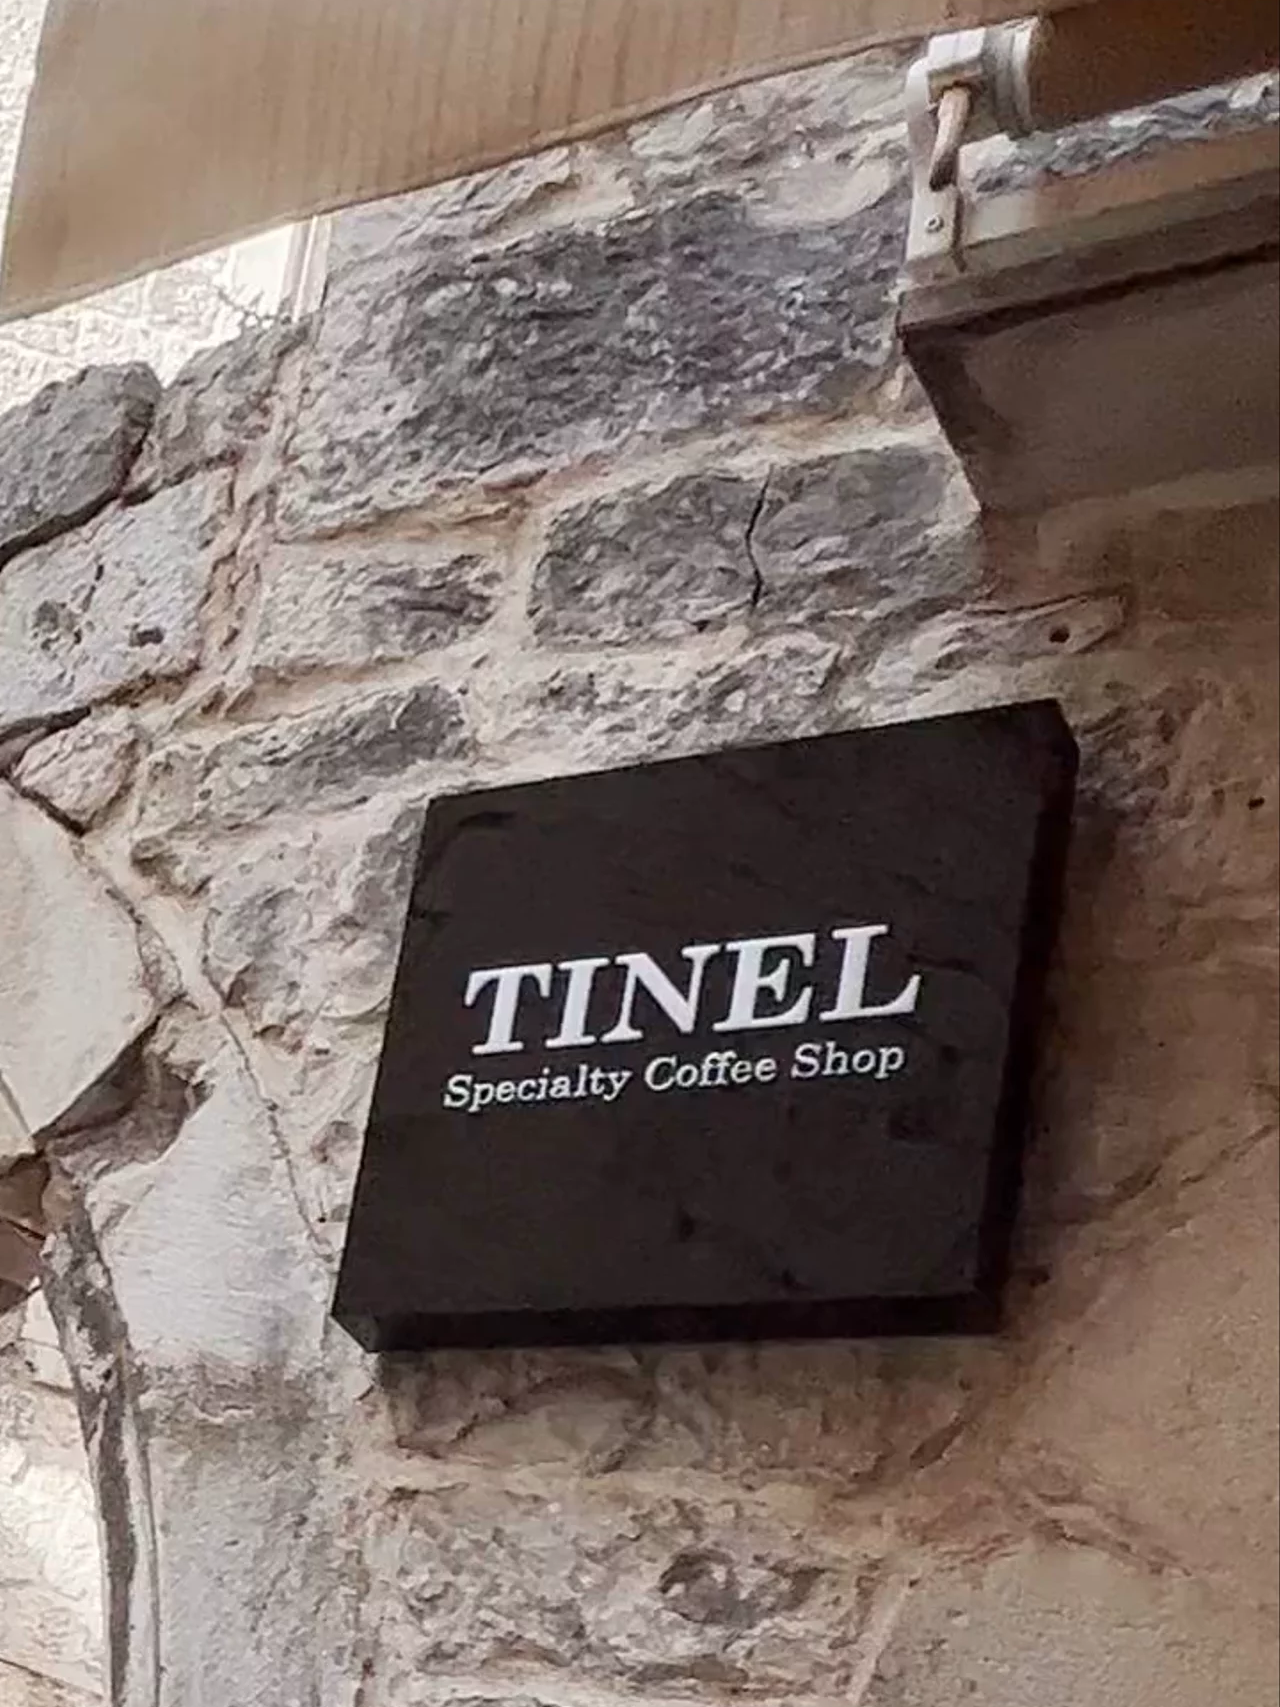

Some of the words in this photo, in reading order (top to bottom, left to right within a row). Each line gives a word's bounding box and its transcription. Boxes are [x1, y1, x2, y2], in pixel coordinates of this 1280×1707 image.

[463, 924, 922, 1055] TINEL
[442, 1063, 633, 1113] Specialty
[644, 1050, 777, 1093] Coffee
[790, 1040, 906, 1080] Shop
